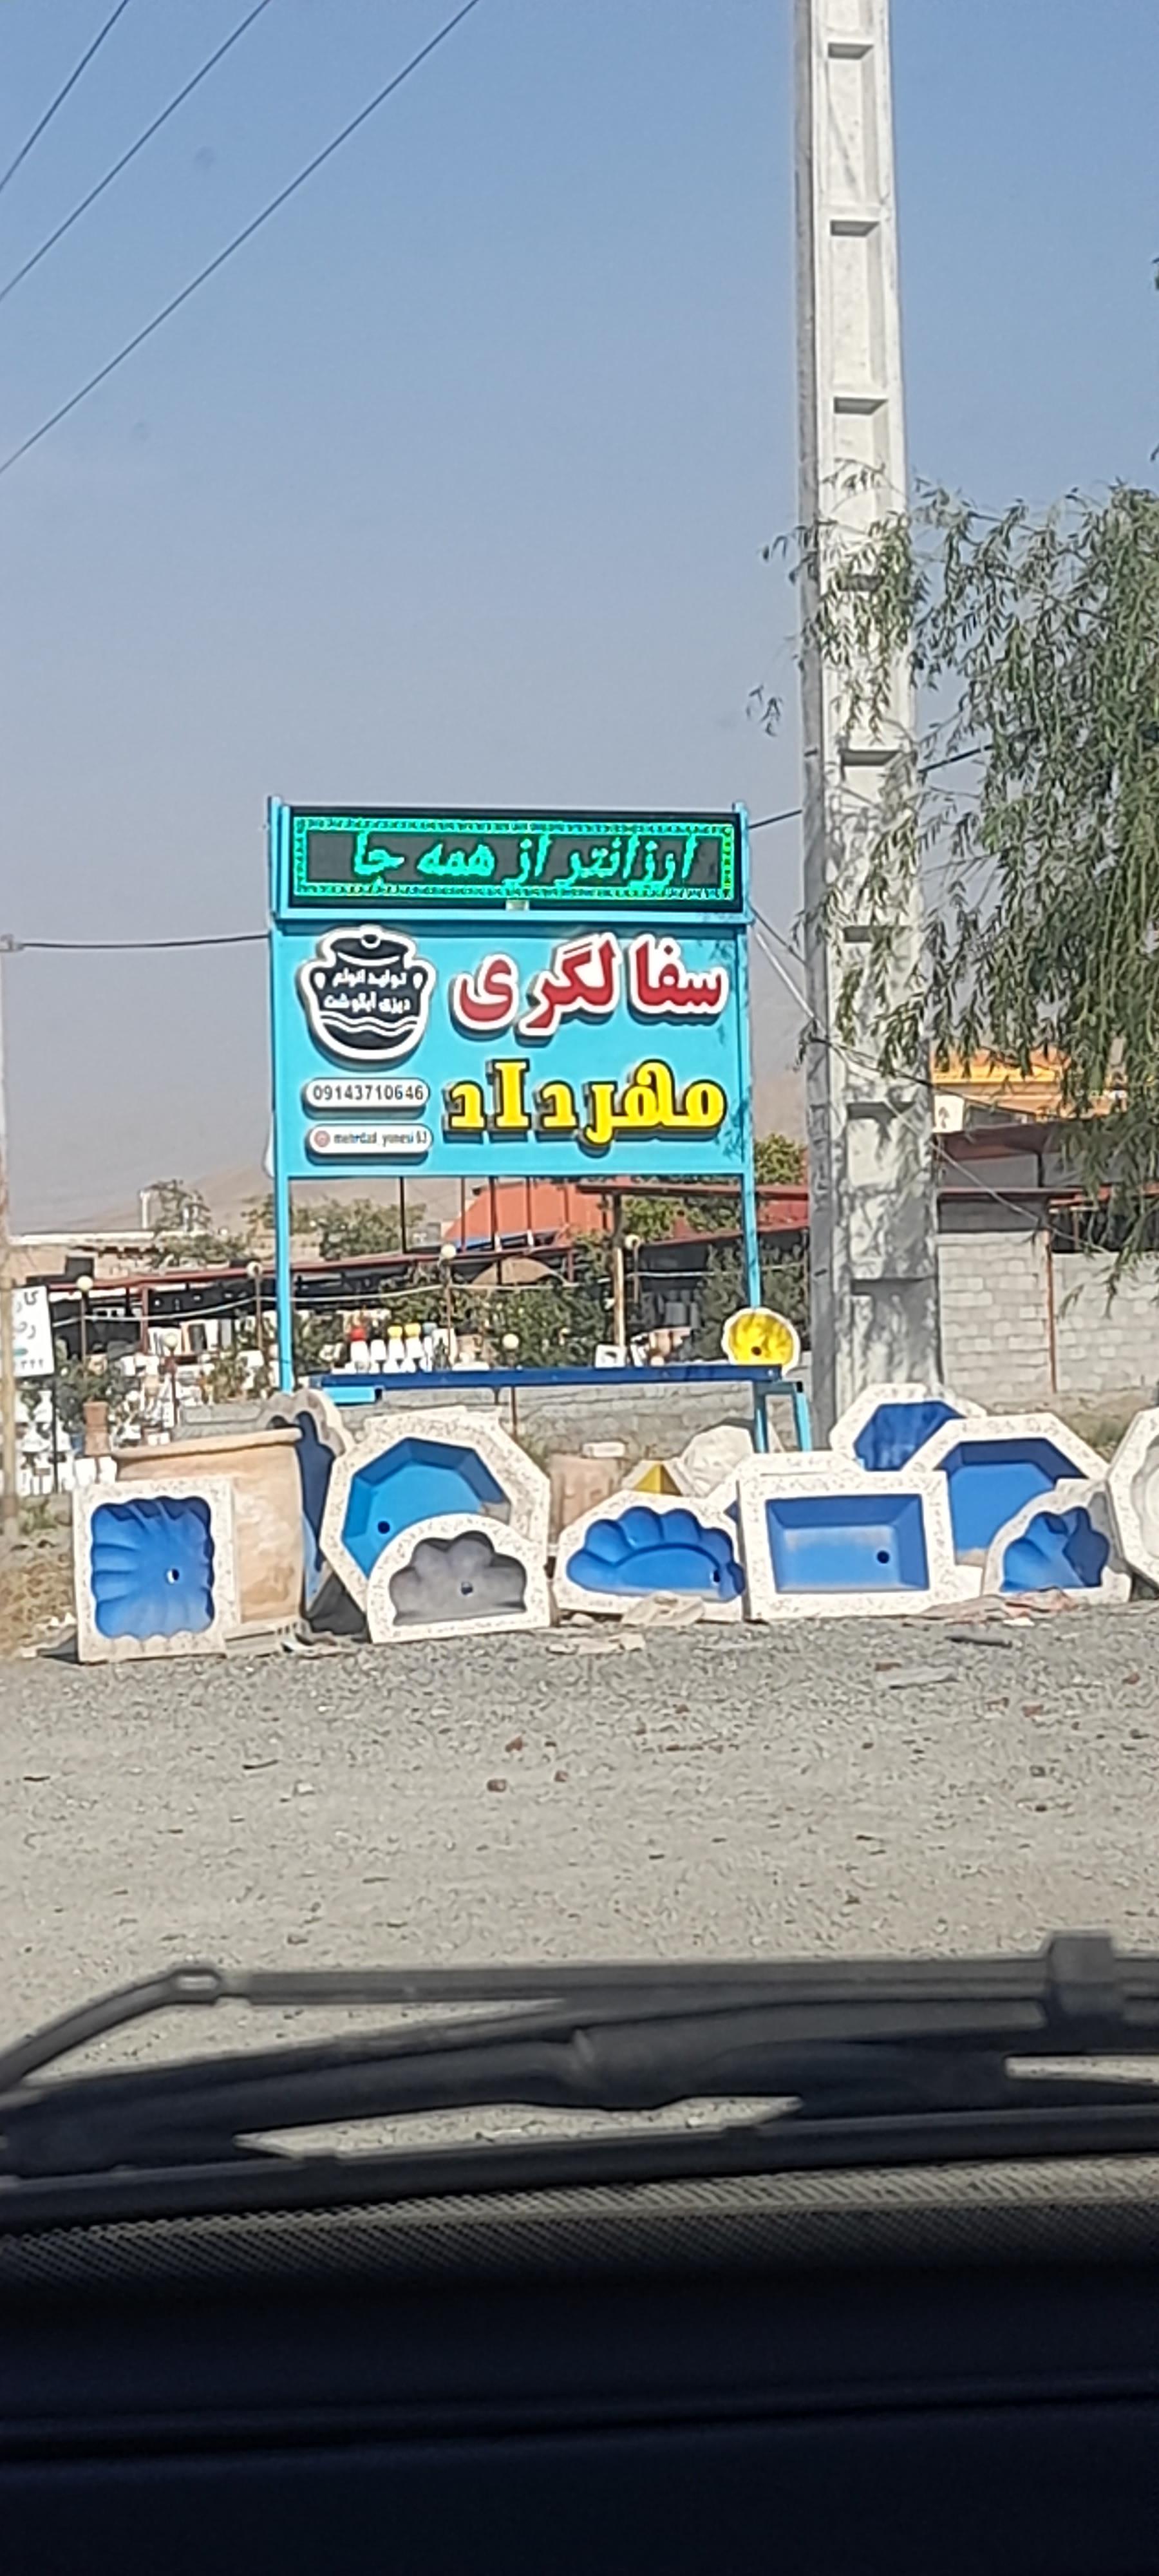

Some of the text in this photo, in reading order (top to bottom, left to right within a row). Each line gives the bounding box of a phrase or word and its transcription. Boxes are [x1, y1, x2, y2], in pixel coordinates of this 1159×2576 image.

[355, 829, 698, 888] ارزانتر از همه جا
[312, 1083, 424, 1101] 09143710646
[450, 1061, 725, 1144] مهرداد
